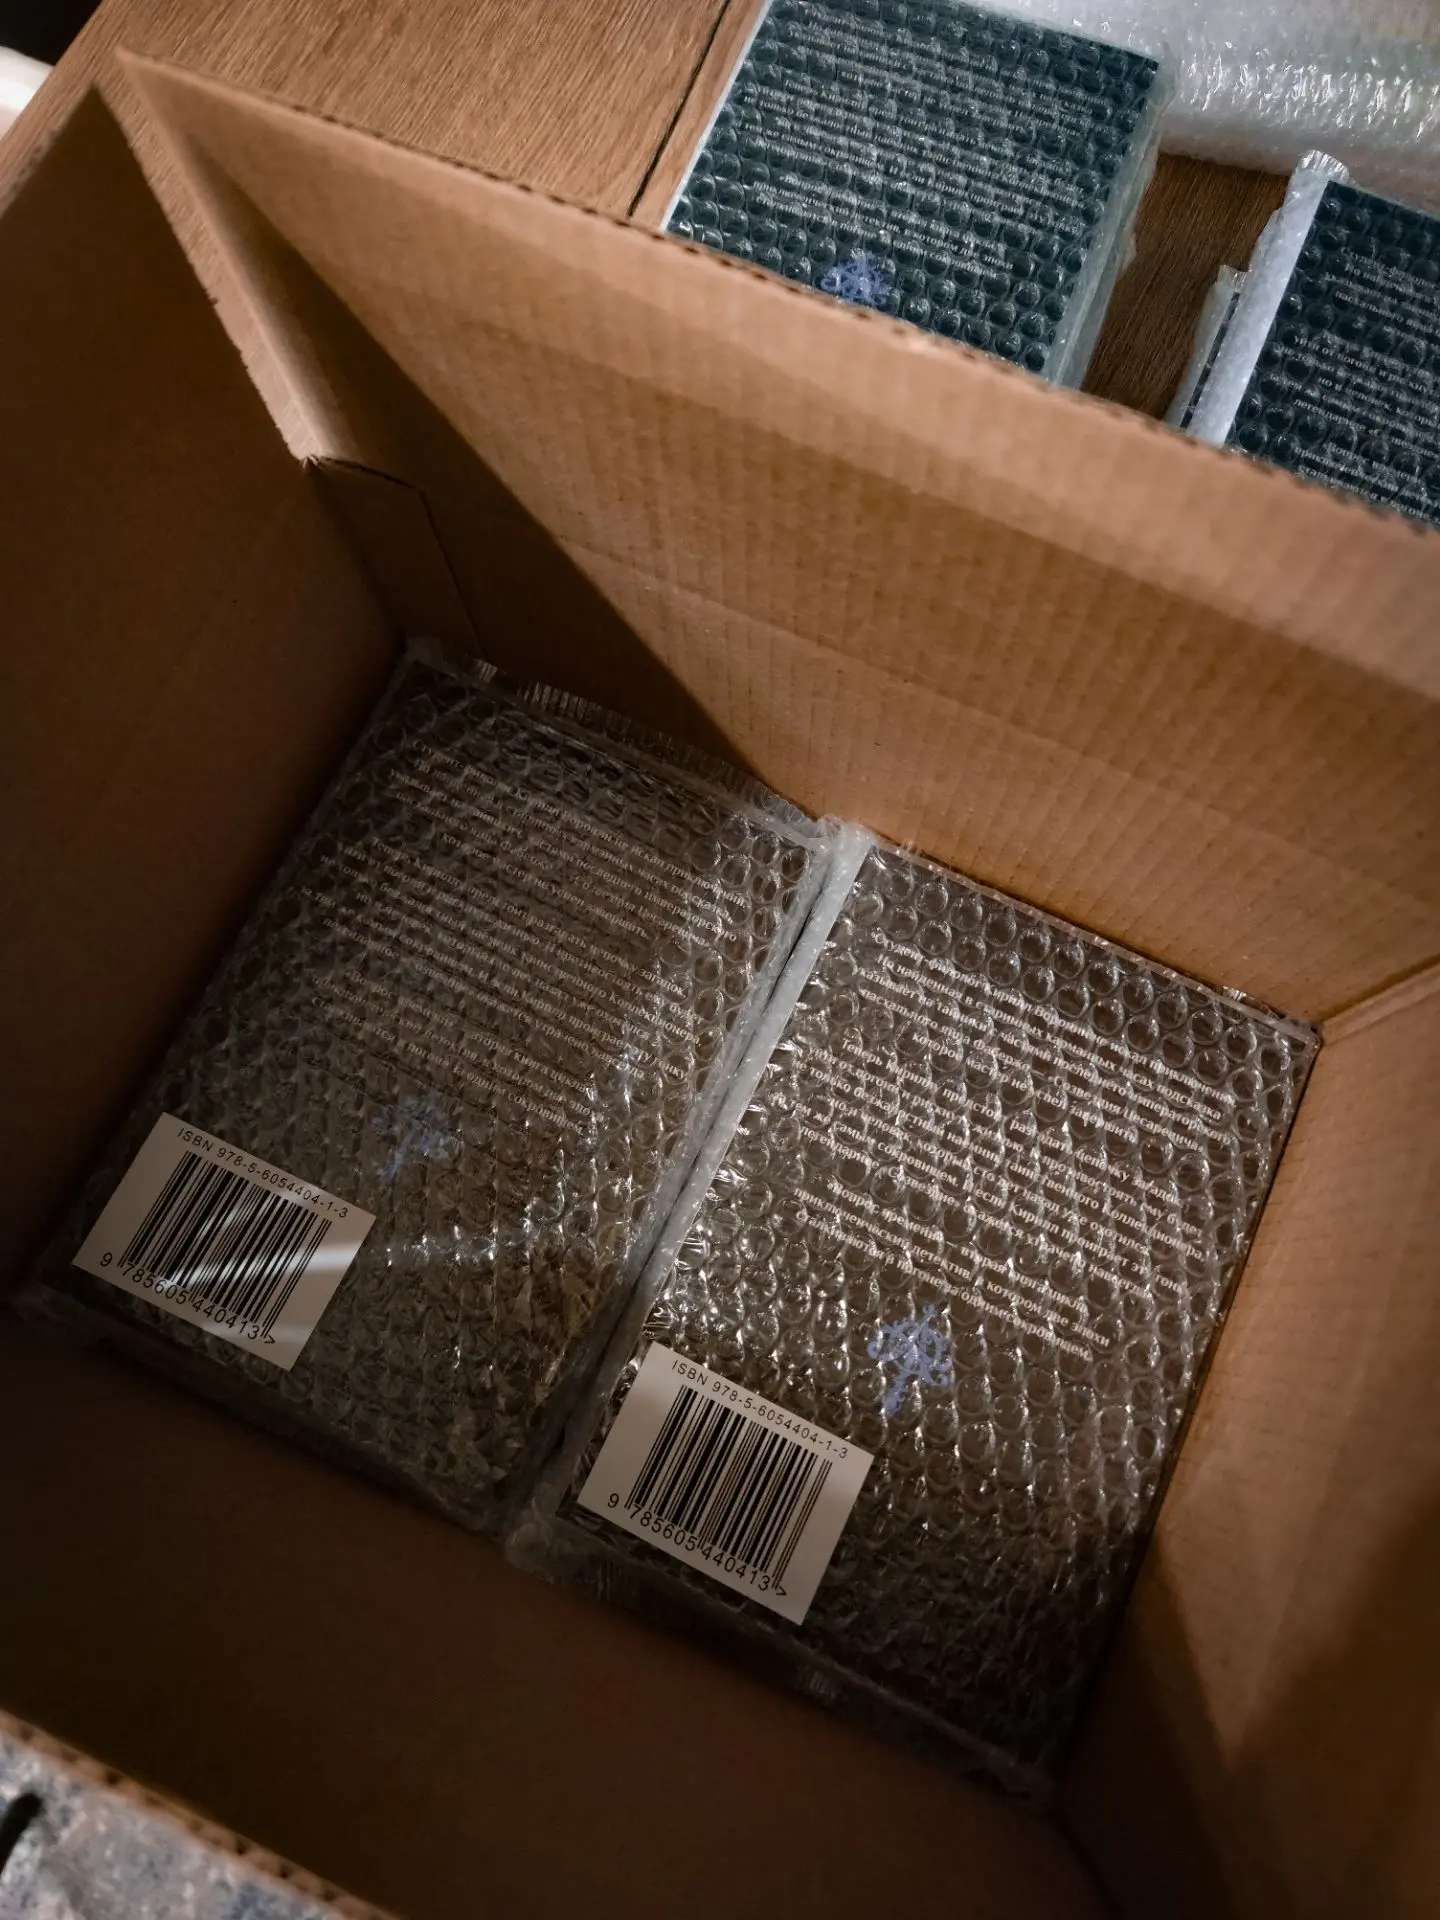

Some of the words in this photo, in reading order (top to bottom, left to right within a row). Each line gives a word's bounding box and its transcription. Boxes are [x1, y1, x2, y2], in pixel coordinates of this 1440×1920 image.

[178, 1128, 214, 1152] ISBN
[217, 1147, 348, 1219] 978-5-6054404-1-3
[100, 1252, 113, 1266] 9
[672, 1359, 709, 1386] ISBN
[712, 1381, 848, 1459] 978-5-6054404-1-3
[607, 1493, 620, 1508] 9
